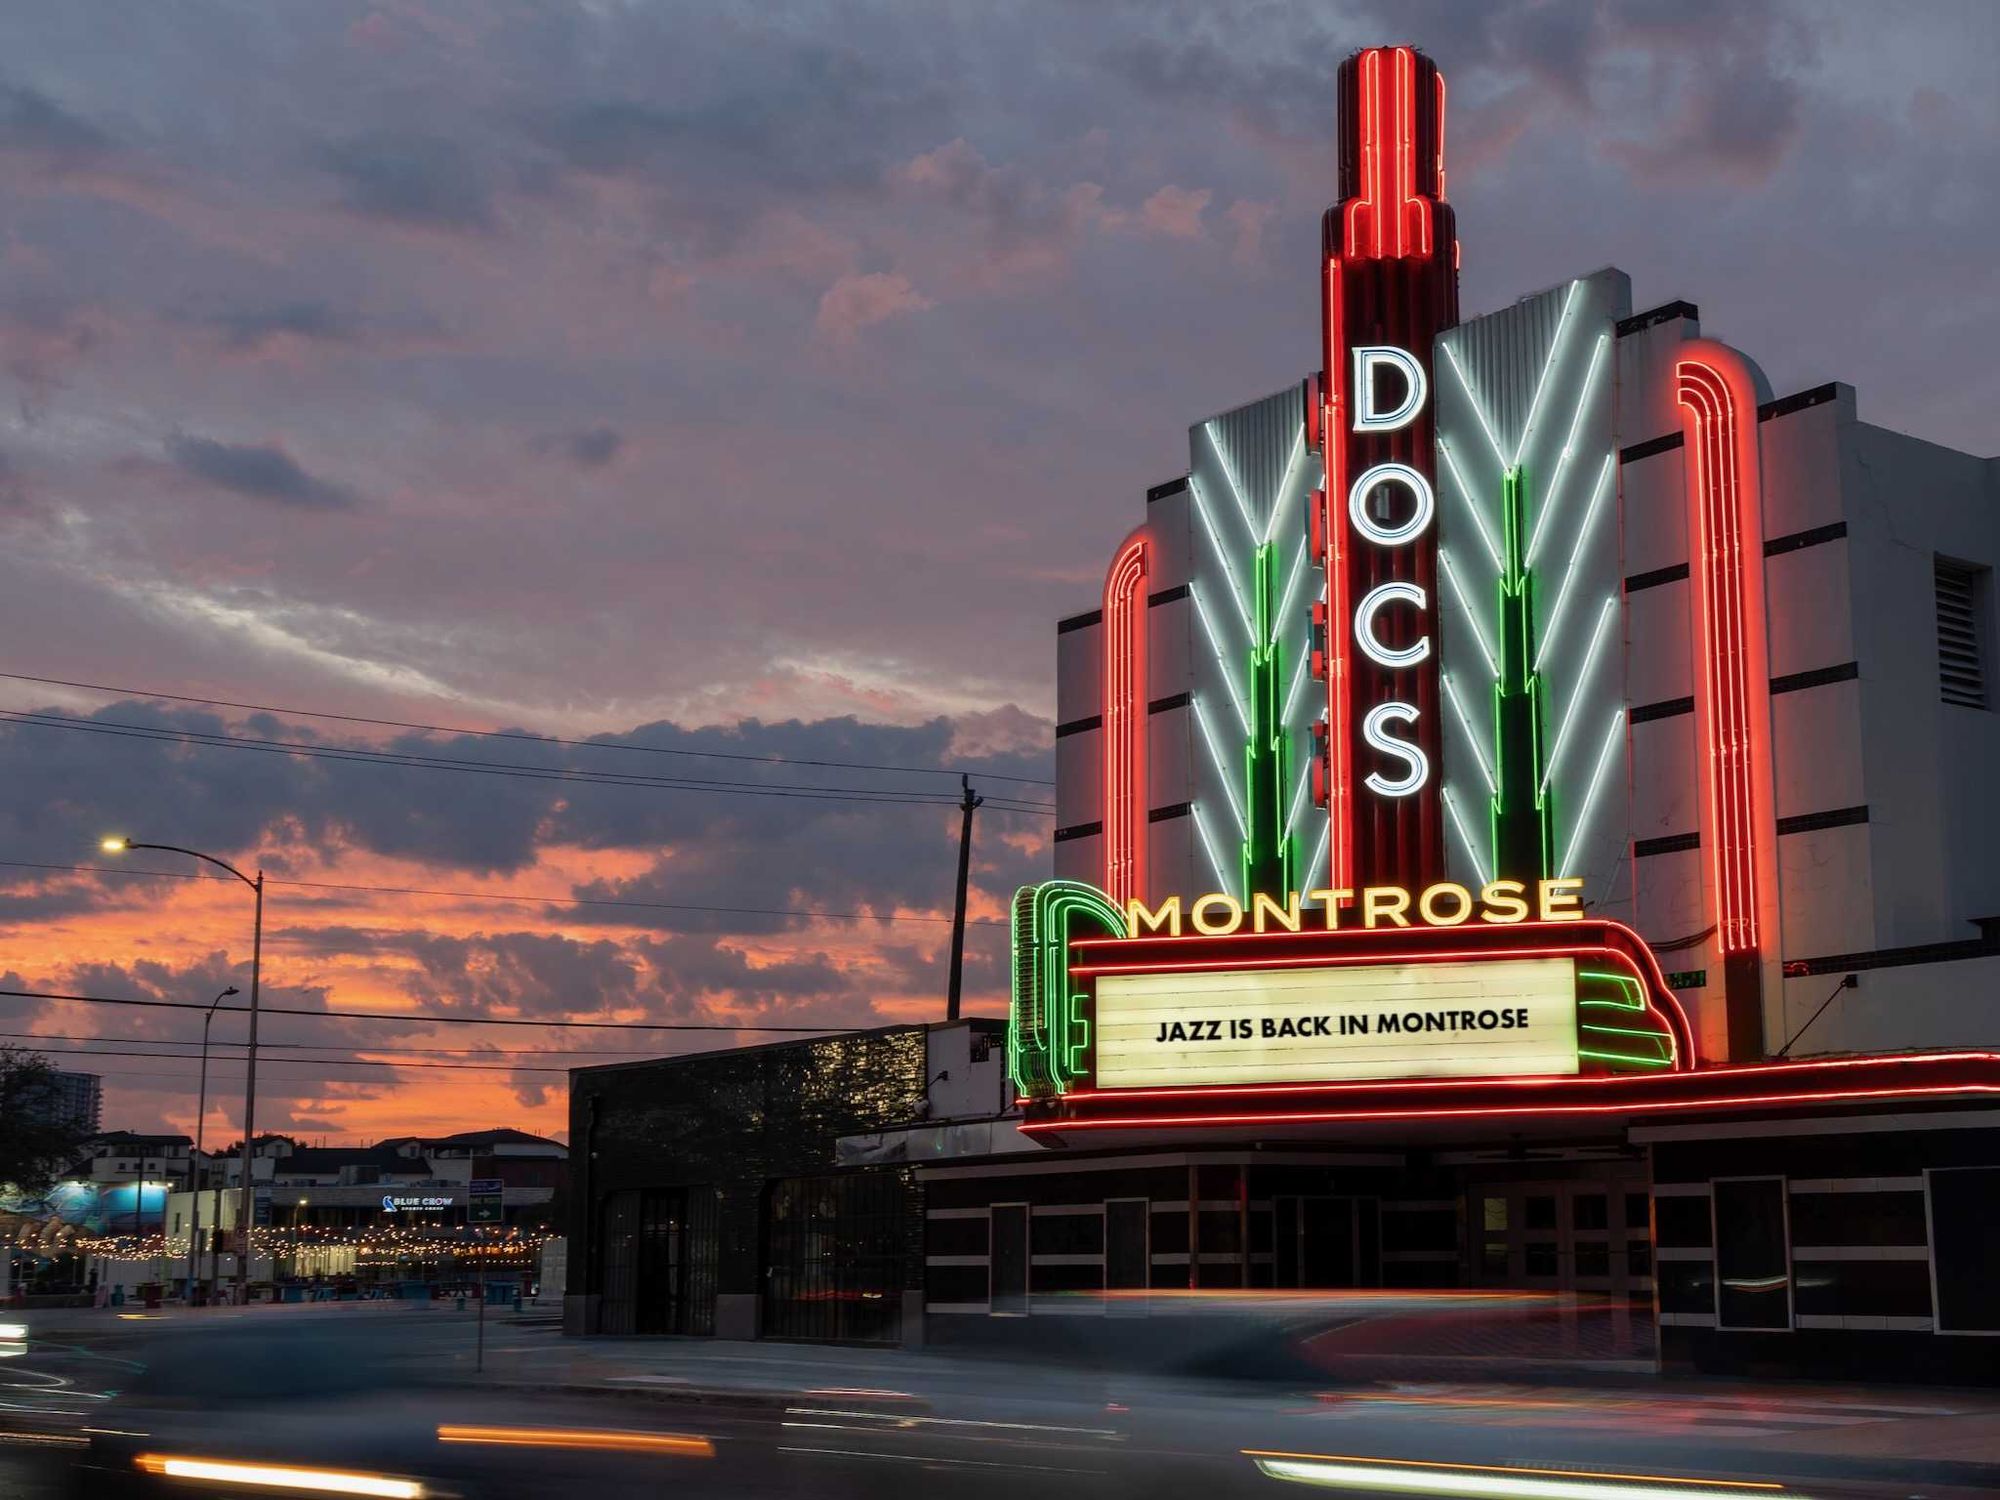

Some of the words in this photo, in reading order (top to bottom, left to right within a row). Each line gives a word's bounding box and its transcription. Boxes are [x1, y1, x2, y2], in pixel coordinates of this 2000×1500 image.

[1348, 345, 1435, 798] DOCS
[1126, 877, 1585, 940] MONTROSE
[1155, 1021, 1222, 1042] JAZZ
[1229, 1018, 1254, 1040] IS
[1260, 1015, 1332, 1038] BACK
[1339, 1014, 1369, 1036] IN
[1376, 1007, 1530, 1034] MONTROSE
[393, 1197, 420, 1206] BLUE
[421, 1197, 454, 1206] CROW
